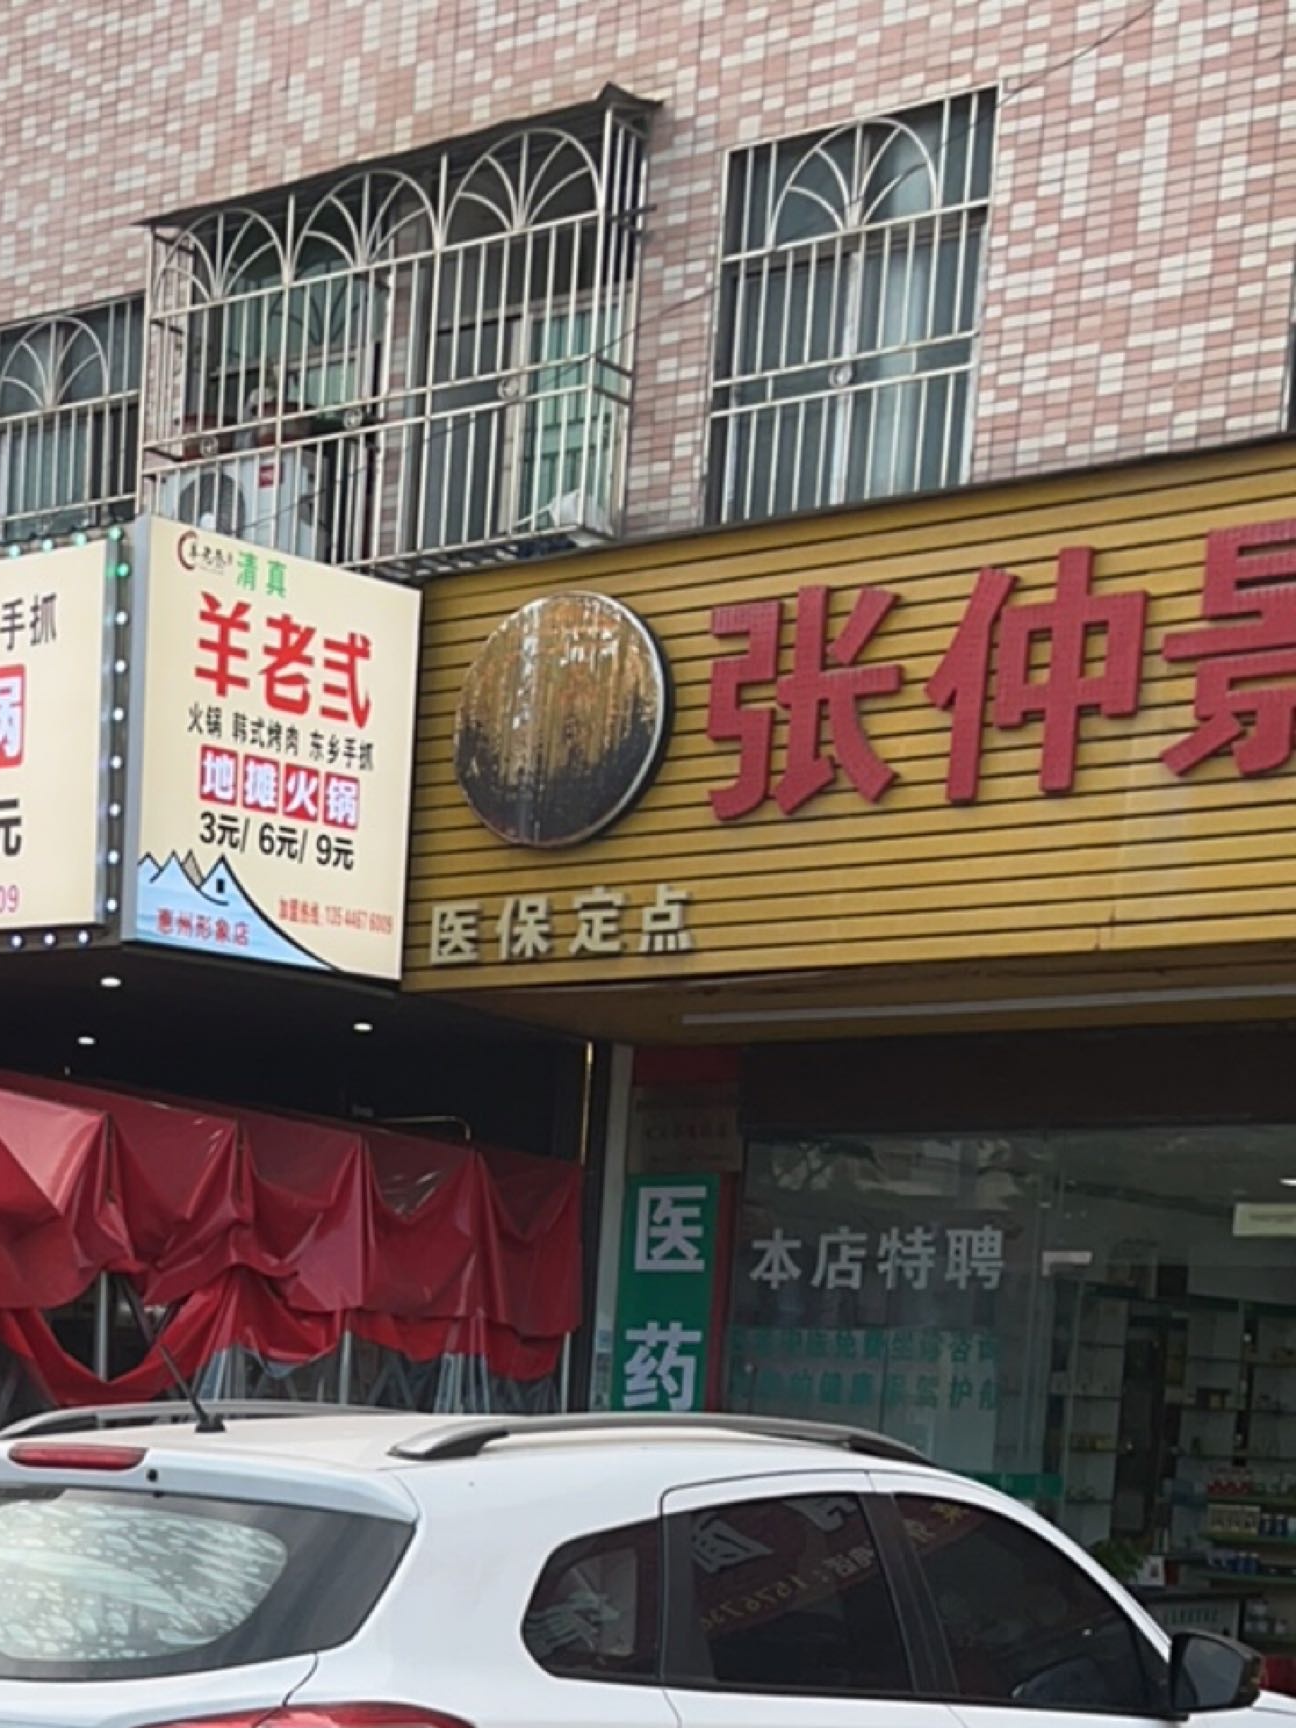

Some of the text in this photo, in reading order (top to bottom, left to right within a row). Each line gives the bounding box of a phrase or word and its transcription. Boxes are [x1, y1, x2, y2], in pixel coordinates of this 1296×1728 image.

[236, 550, 286, 598] 清真
[706, 518, 1296, 822] 张仲景
[186, 702, 223, 739] 火锅
[200, 750, 358, 830] 地摊火锅
[199, 811, 355, 870] 3元/ 6元/ 9元
[429, 884, 697, 966] 医保定点
[749, 1225, 1005, 1292] 本店特聘
[622, 1186, 707, 1413] 医药
